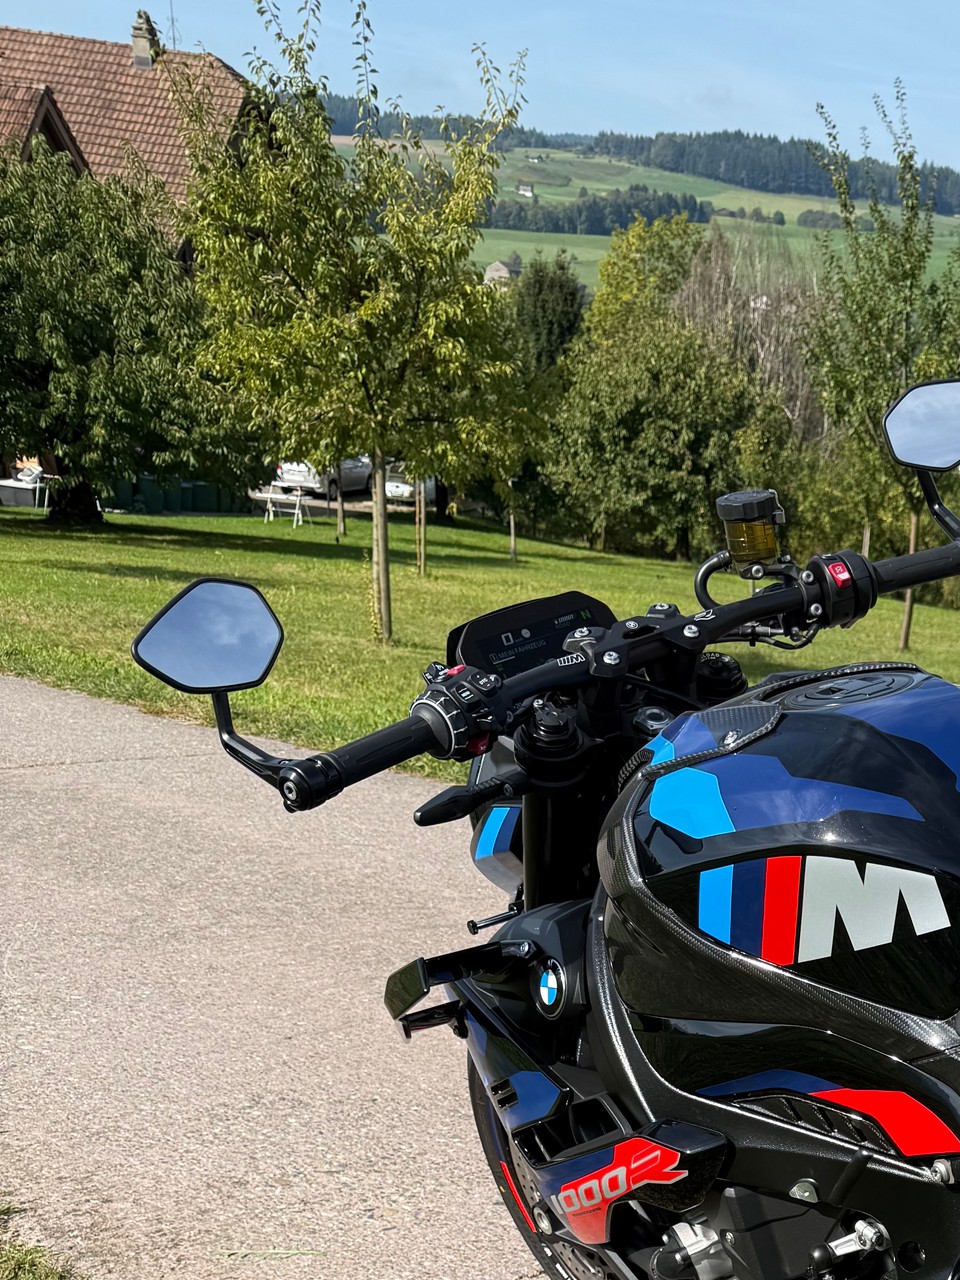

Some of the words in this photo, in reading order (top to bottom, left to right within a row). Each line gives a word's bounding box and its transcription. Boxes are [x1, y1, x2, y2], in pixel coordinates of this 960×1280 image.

[498, 648, 515, 659] MEIN
[515, 640, 547, 655] FAHRZEUG
[798, 855, 951, 963] M
